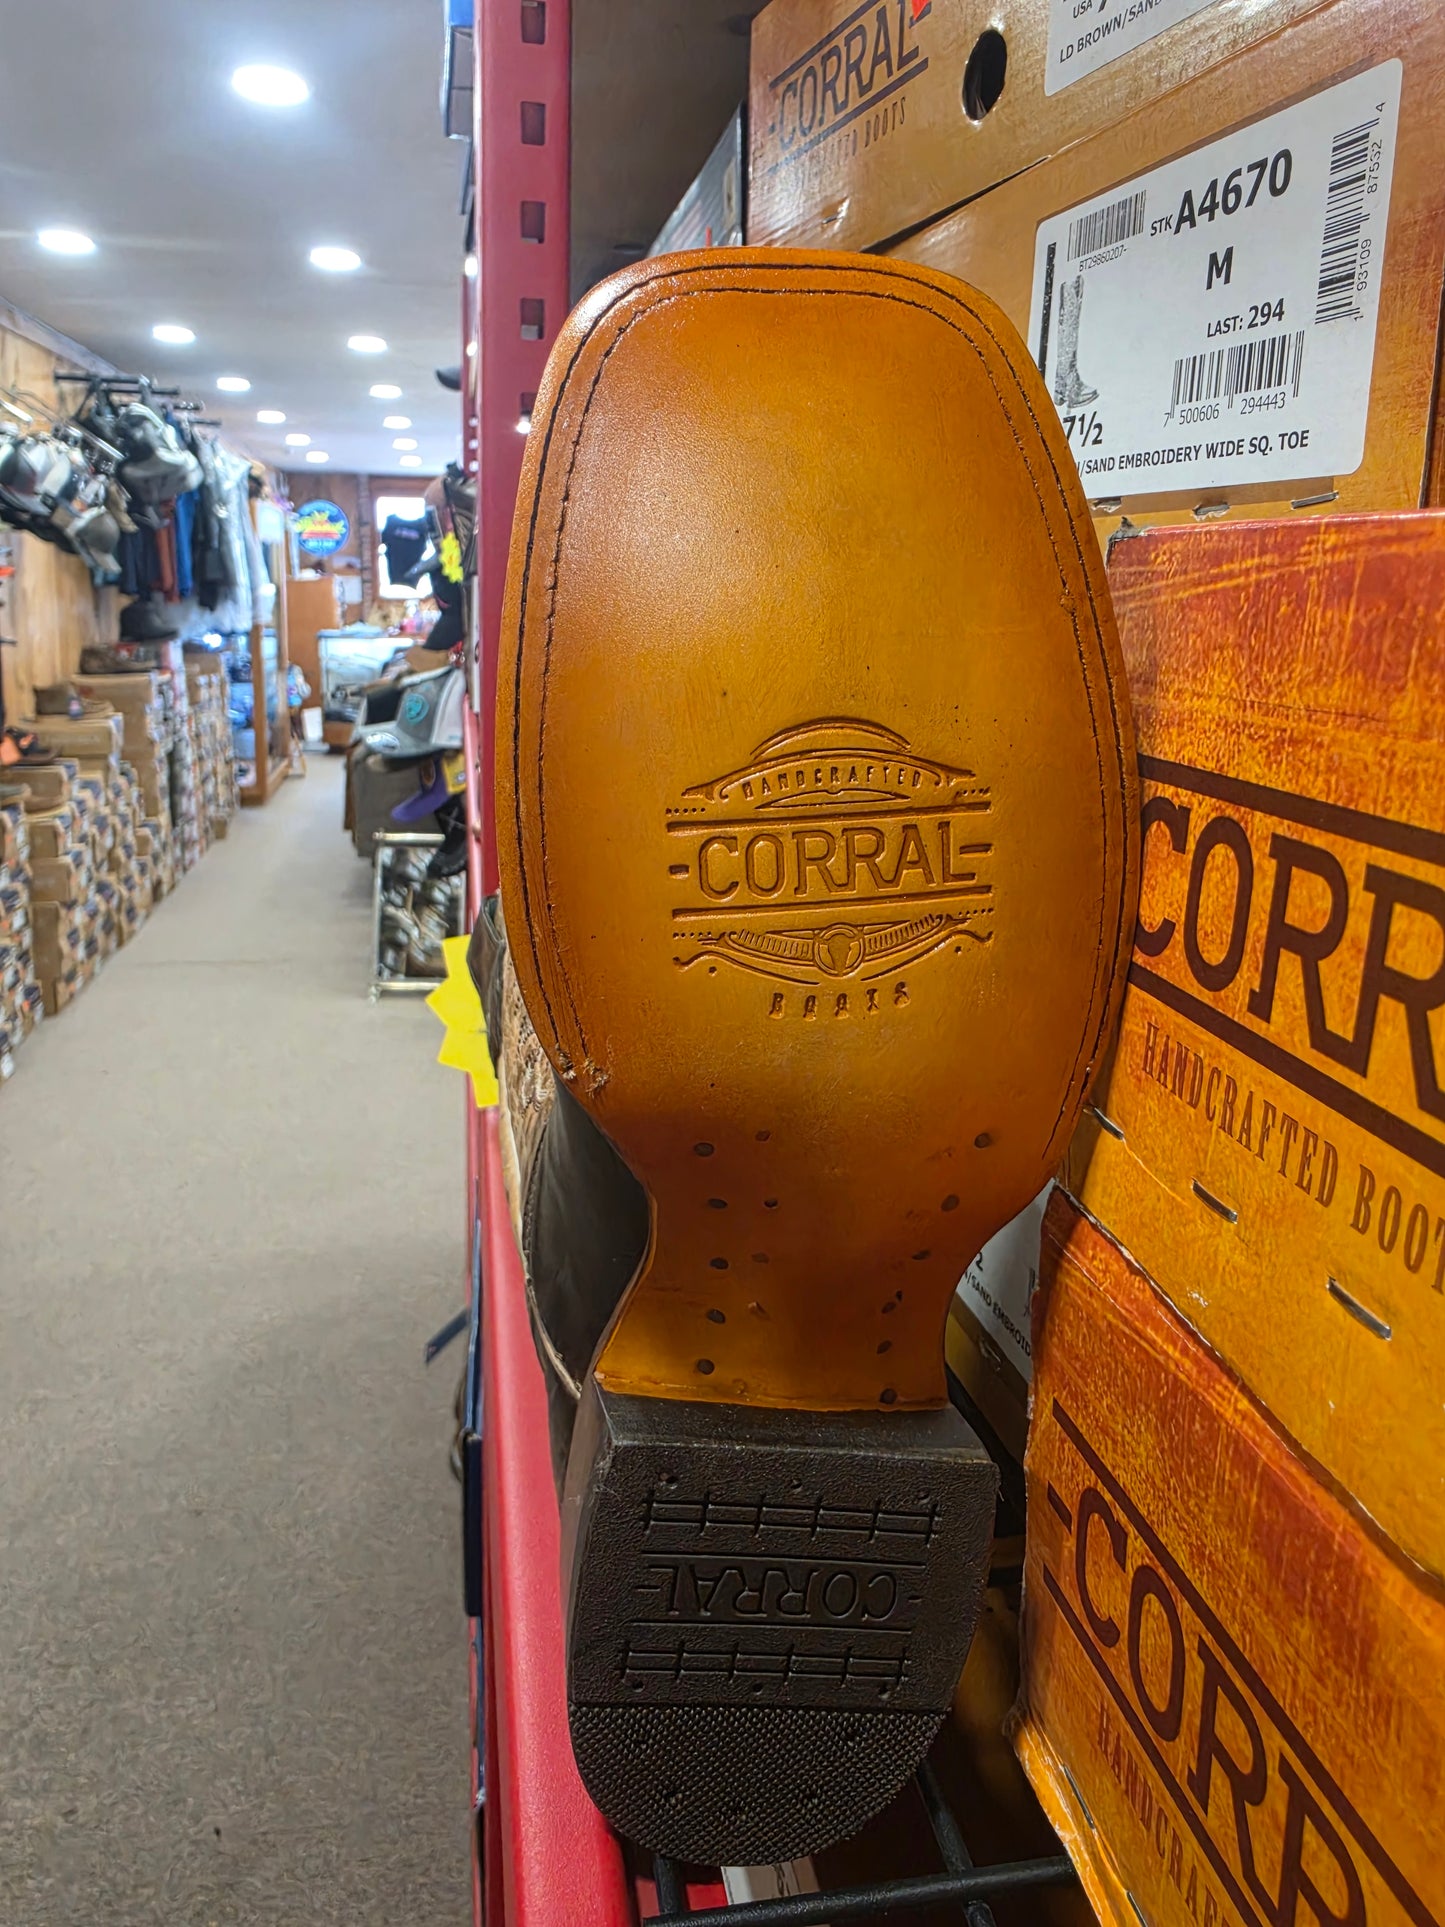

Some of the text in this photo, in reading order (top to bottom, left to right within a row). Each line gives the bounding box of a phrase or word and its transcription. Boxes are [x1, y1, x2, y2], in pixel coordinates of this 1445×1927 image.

[1072, 1, 1093, 19] USA
[779, 0, 919, 151] CORRAL
[1059, 44, 1075, 64] LD
[864, 96, 906, 149] BOOTS
[1150, 148, 1293, 237] STK A4670
[1206, 246, 1235, 290] M
[1356, 238, 1372, 292] 93109
[1206, 298, 1285, 338] LAST: 294
[1163, 391, 1286, 428] 7 500606 294443
[1118, 444, 1203, 470] EMBROIDERY
[1205, 438, 1245, 459] WIDE
[1248, 435, 1273, 456] SQ.
[1278, 429, 1310, 451] TOE
[698, 820, 978, 903] CORRAL
[1143, 1021, 1340, 1210] HANDCRAFTED
[649, 1562, 900, 1622] CORRAL
